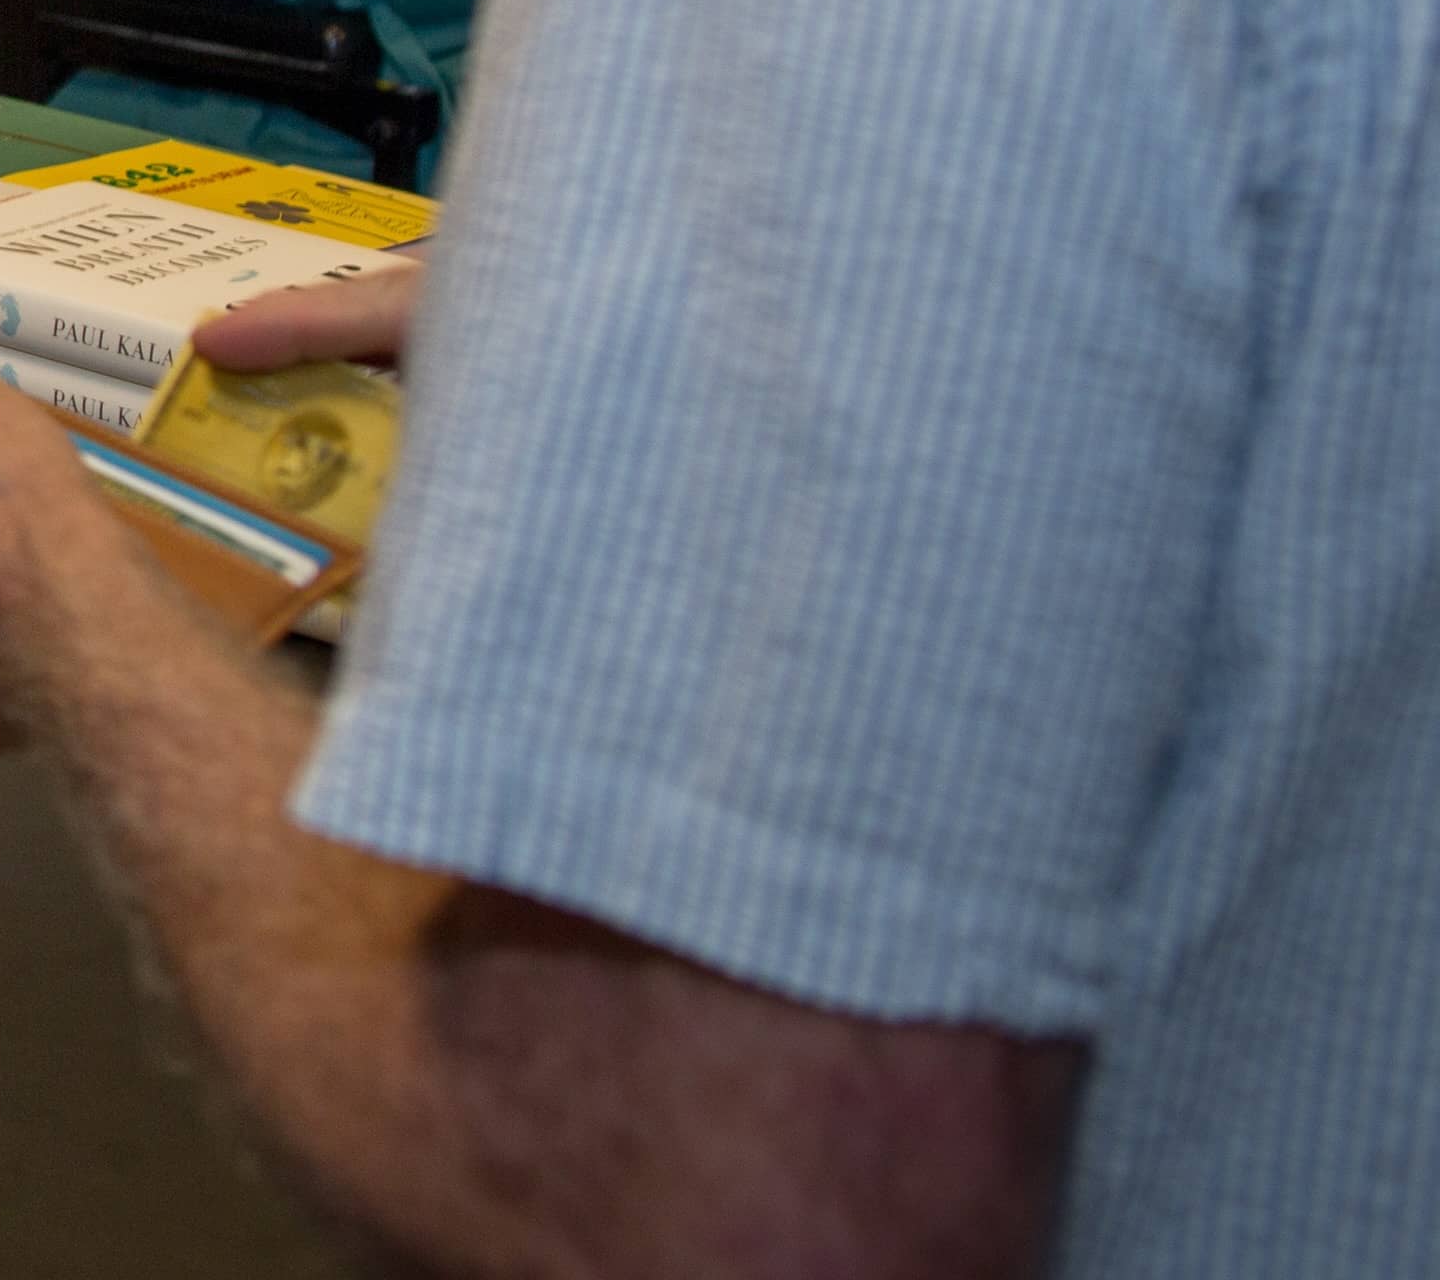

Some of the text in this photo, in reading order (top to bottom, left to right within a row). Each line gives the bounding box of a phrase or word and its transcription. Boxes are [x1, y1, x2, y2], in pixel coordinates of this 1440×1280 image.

[53, 223, 217, 272] BREATH
[108, 235, 269, 287] BECOMES
[52, 316, 110, 351] PAUL
[53, 389, 111, 426] PAUL
